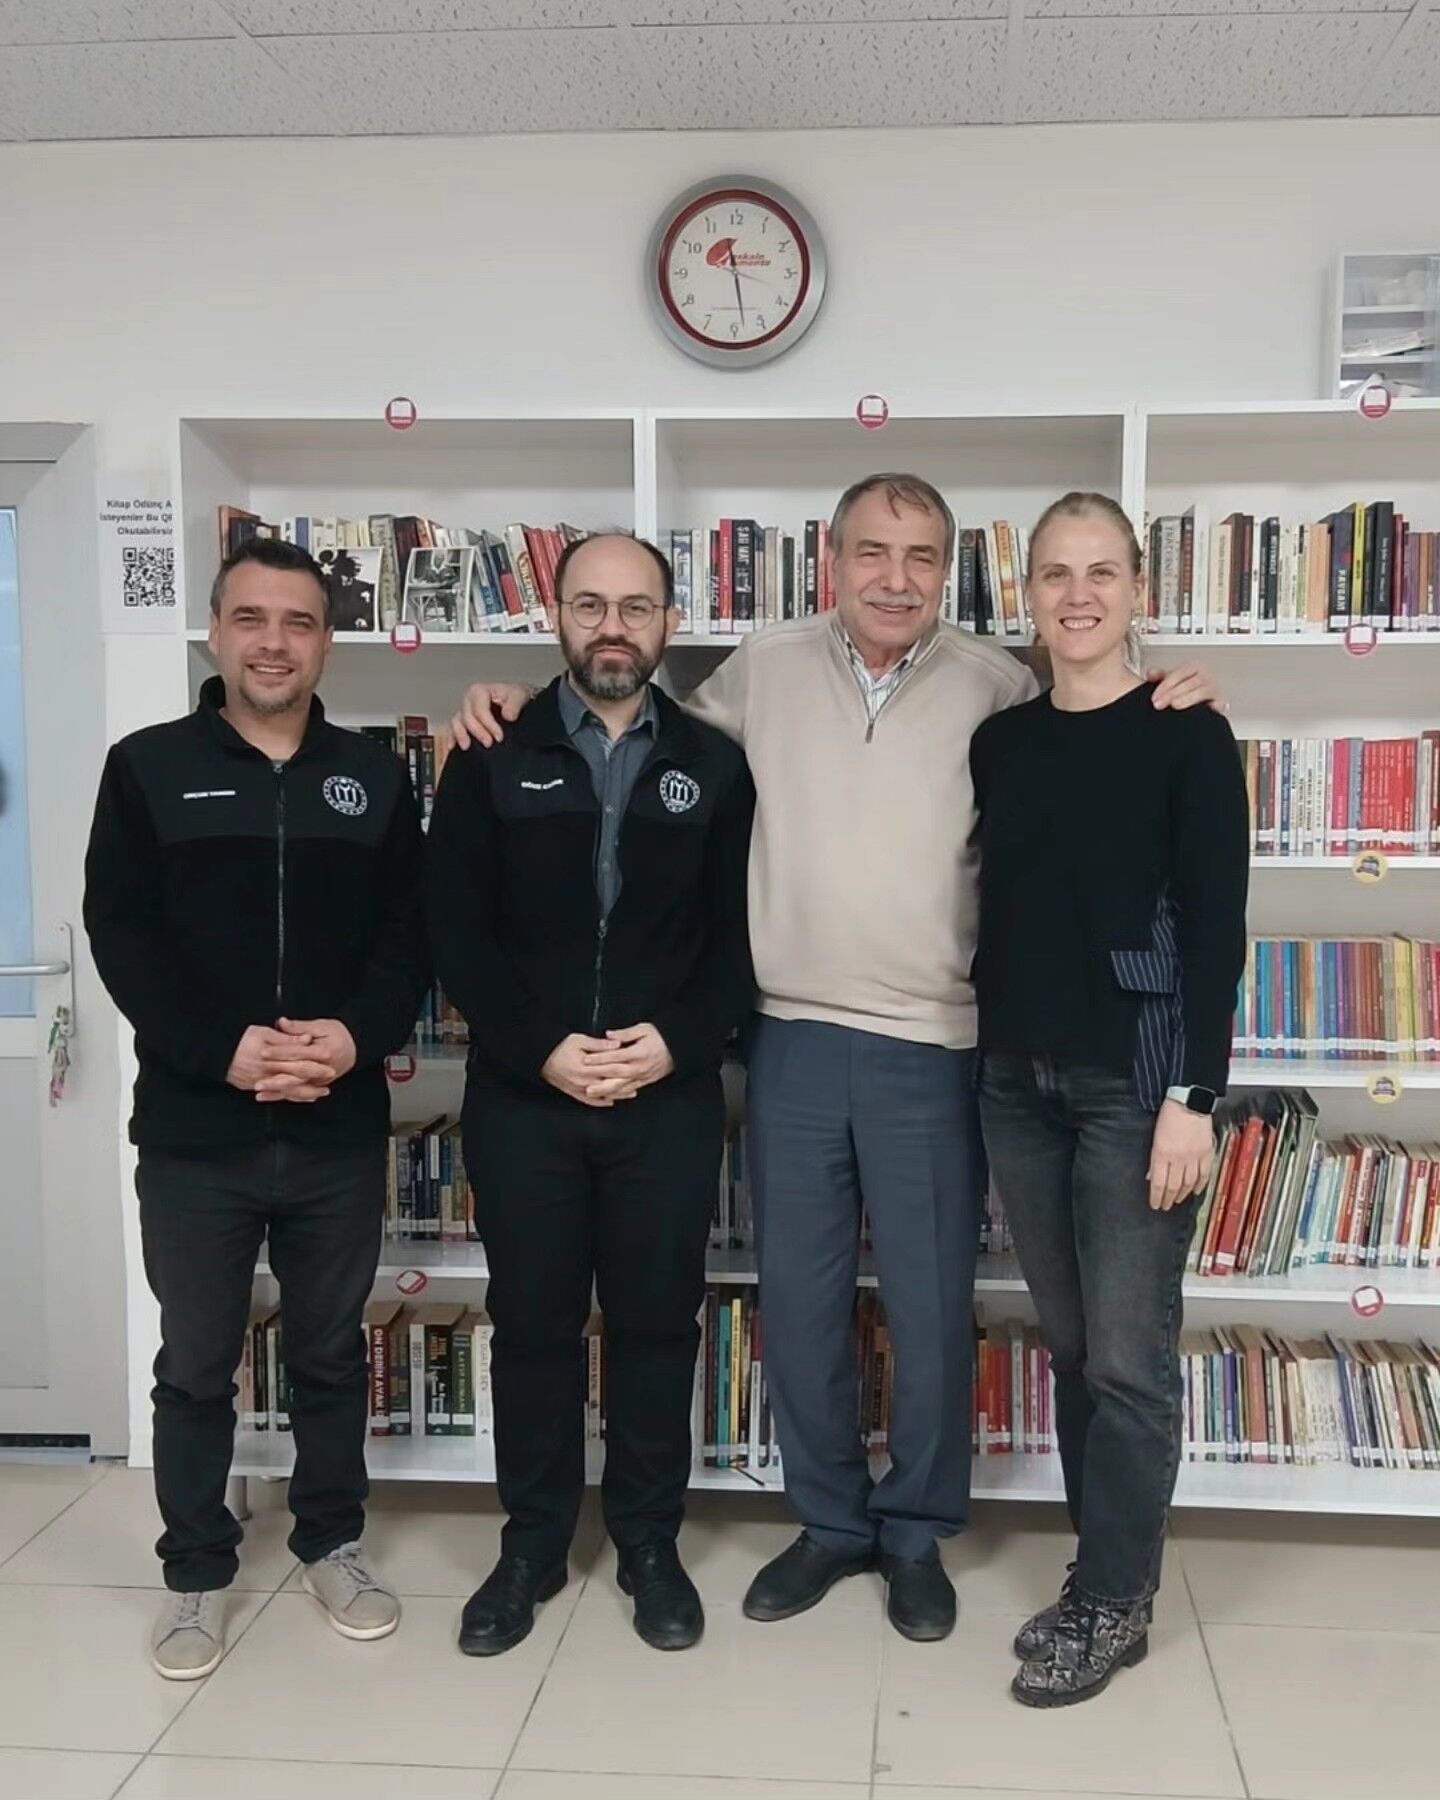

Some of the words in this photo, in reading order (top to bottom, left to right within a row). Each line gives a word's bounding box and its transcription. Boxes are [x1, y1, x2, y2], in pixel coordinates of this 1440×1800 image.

[730, 214, 744, 225] 12
[706, 222, 717, 234] 11
[687, 243, 702, 254] 10
[777, 242, 786, 253] 2
[679, 268, 688, 279] 9
[784, 268, 793, 279] 3
[686, 295, 695, 305] 8
[775, 296, 783, 306] 4
[730, 322, 739, 333] 6
[106, 499, 131, 509] Kitap
[133, 498, 162, 510] Ödünç
[146, 513, 159, 521] Bu
[373, 1328, 384, 1345] ON
[373, 1380, 385, 1409] AYAK
